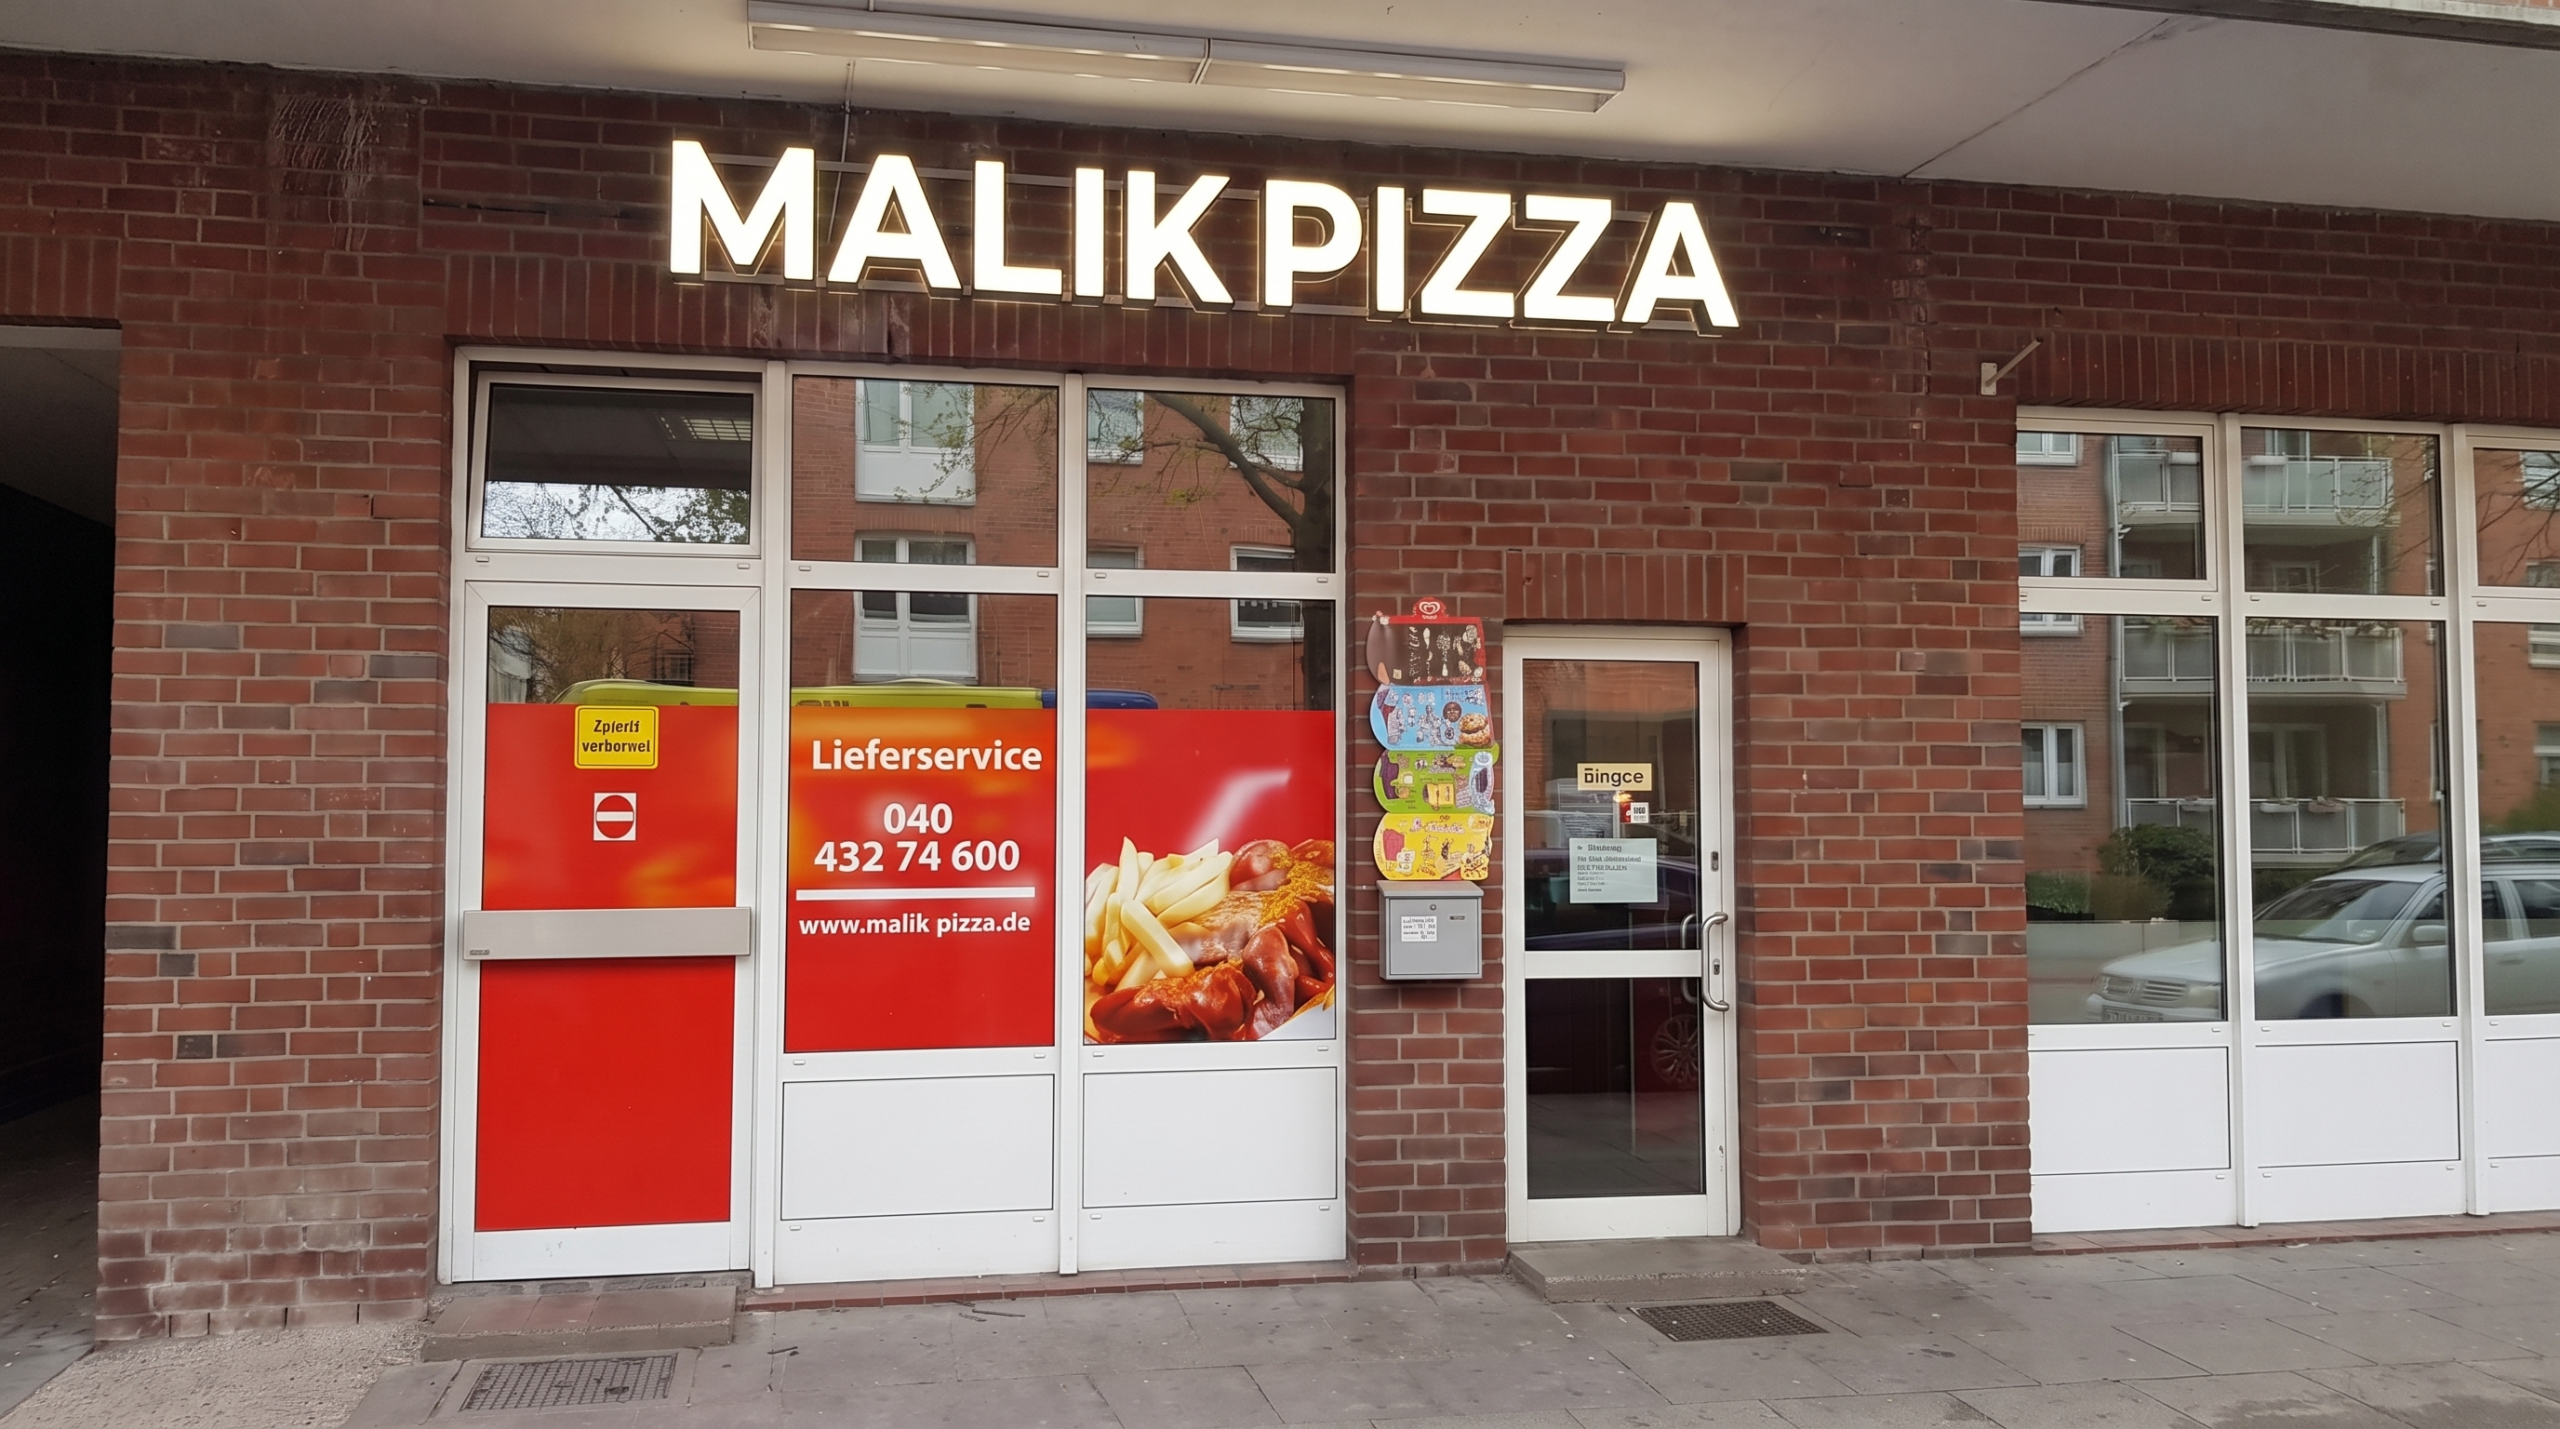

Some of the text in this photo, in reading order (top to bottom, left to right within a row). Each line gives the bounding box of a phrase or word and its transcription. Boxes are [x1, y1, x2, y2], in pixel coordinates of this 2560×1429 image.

[670, 139, 1740, 329] MALIK PIZZA
[812, 738, 1043, 771] Lieferservice
[883, 803, 953, 834] 040
[813, 840, 1020, 872] 432 74 600
[799, 911, 1031, 938] www.malik pizza.de
